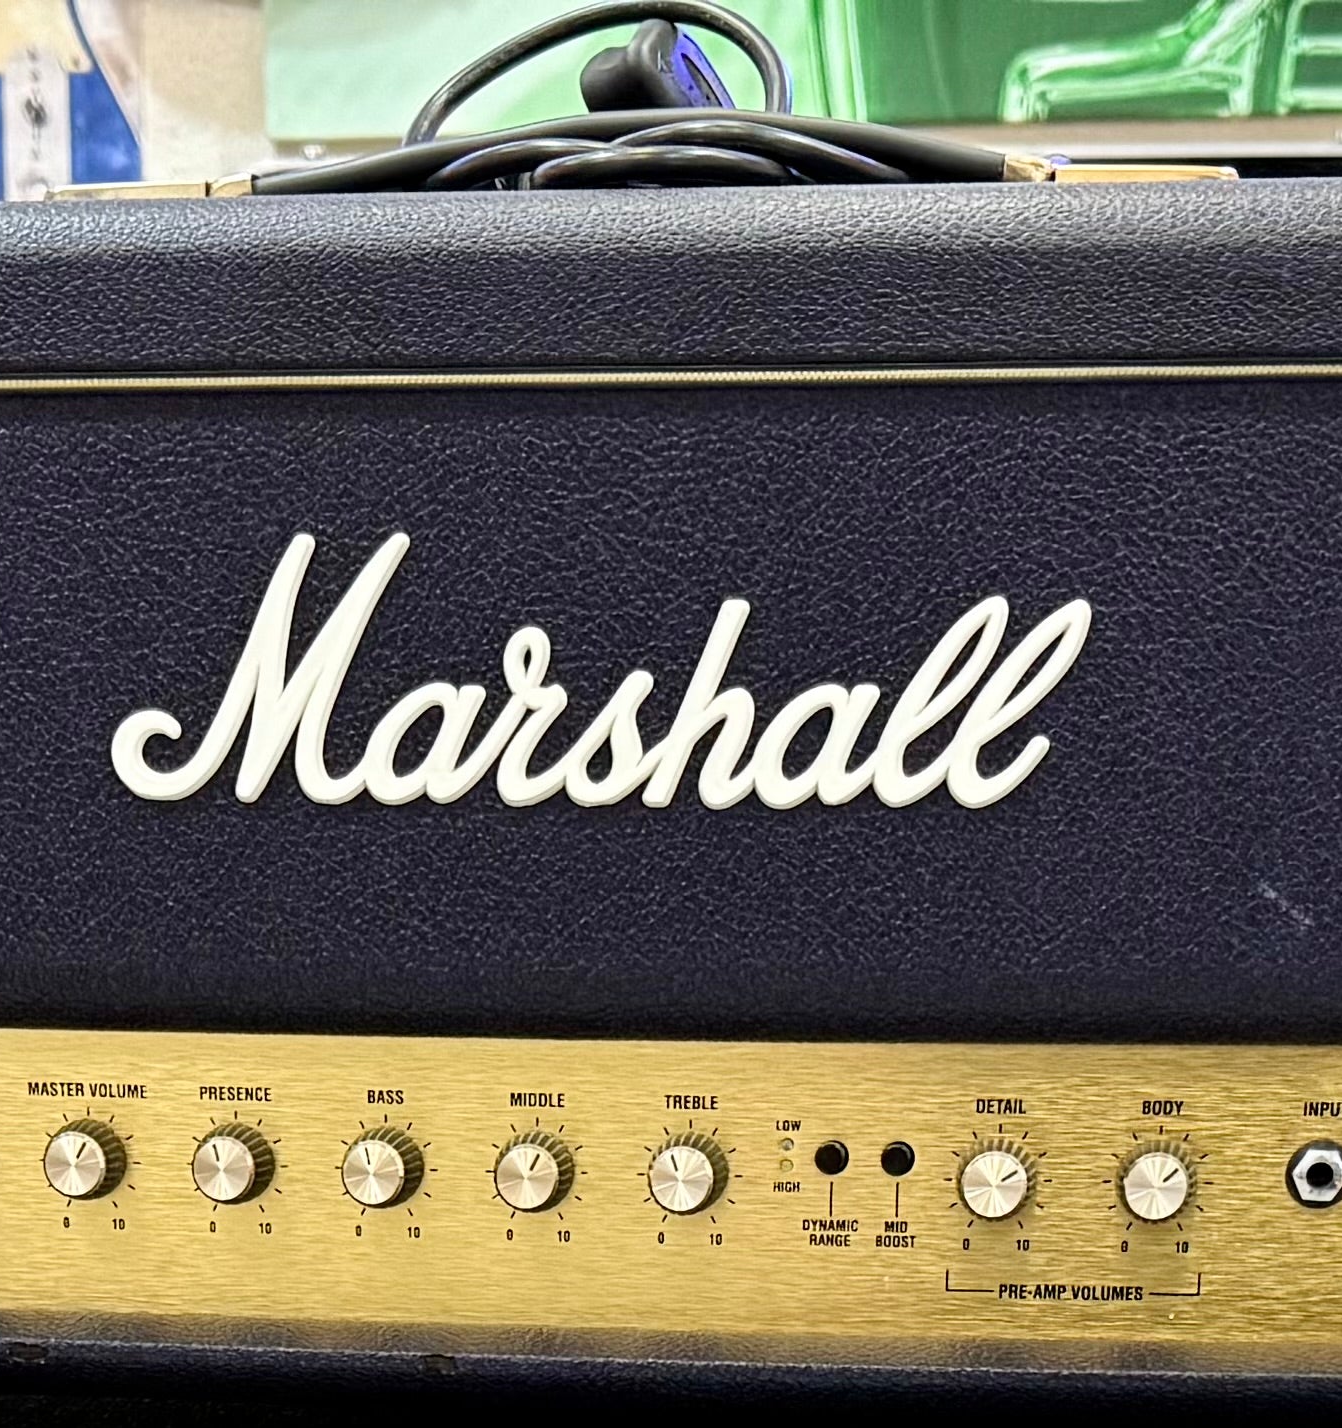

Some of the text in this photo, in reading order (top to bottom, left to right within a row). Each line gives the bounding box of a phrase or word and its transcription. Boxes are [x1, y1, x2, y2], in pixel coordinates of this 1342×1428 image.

[111, 532, 1092, 809] Marshall
[27, 1081, 147, 1099] MASTER VOLUME
[199, 1086, 272, 1102] PRESENCE
[367, 1089, 404, 1105] BASS
[510, 1092, 565, 1108] MIDDLE
[664, 1094, 718, 1110] TREBLE
[975, 1098, 1027, 1115] DETAIL
[1142, 1100, 1184, 1117] BODY
[775, 1119, 802, 1132] LOW
[773, 1181, 801, 1193] HIGH
[63, 1216, 70, 1229] 0
[112, 1218, 126, 1230] 10
[209, 1220, 217, 1233] 0
[258, 1222, 272, 1235] 10
[802, 1219, 859, 1233] DYNAMIC
[884, 1221, 908, 1234] MID
[355, 1224, 362, 1237] 0
[407, 1226, 421, 1239] 10
[506, 1228, 514, 1241] 0
[557, 1230, 571, 1243] 10
[657, 1231, 665, 1245] 0
[709, 1233, 723, 1246] 10
[809, 1233, 851, 1247] RANGE
[875, 1234, 917, 1249] BOOST
[962, 1238, 970, 1251] 0
[1016, 1239, 1030, 1252] 10
[1120, 1240, 1129, 1253] 0
[1175, 1241, 1189, 1254] 10
[998, 1283, 1144, 1301] PRE-AMP VOLUMES
